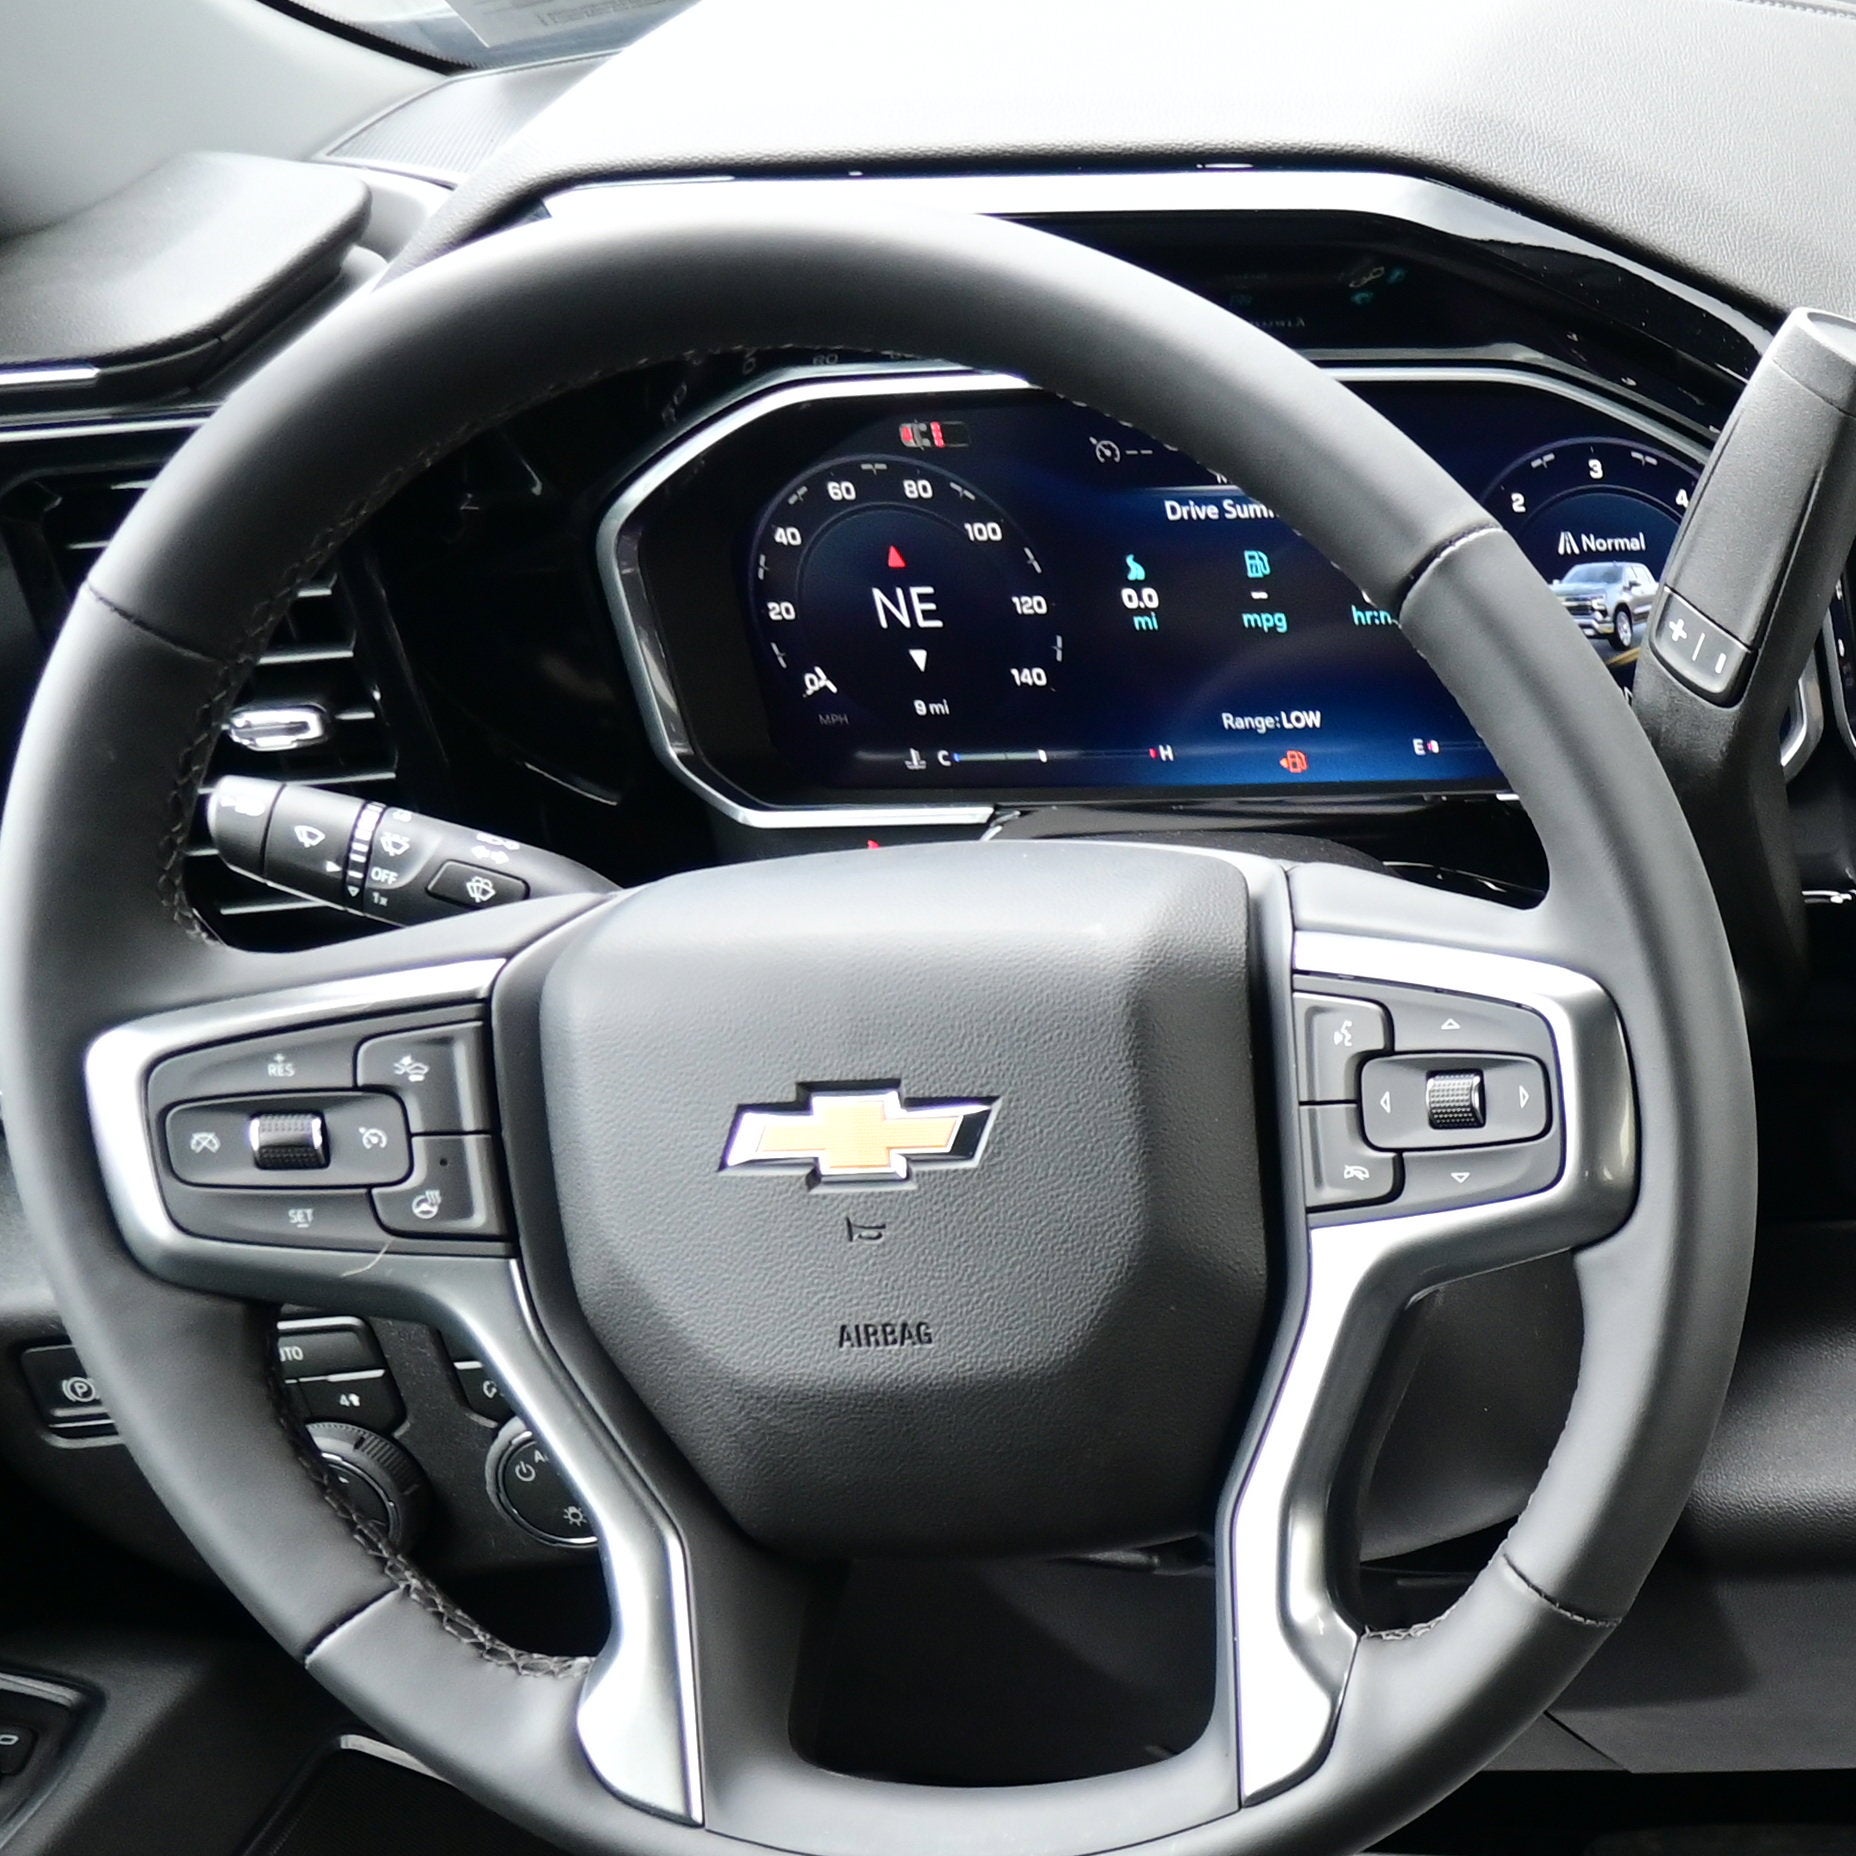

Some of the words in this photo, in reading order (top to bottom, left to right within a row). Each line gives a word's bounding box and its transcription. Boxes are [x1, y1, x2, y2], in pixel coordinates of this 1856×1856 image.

[1587, 458, 1604, 479] 3
[827, 481, 857, 502] 60
[903, 479, 933, 500] 80
[1675, 488, 1689, 508] 4
[1164, 500, 1219, 521] Drive
[1510, 491, 1527, 513] 2
[774, 526, 802, 547] 40
[964, 522, 1003, 542] 100
[1580, 531, 1647, 552] Normal
[872, 586, 944, 629] NE
[1012, 595, 1048, 616] 120
[1121, 587, 1160, 610] 0.0
[767, 601, 796, 621] 20
[1133, 611, 1159, 633] mi
[1242, 612, 1288, 633] mpg
[1010, 666, 1047, 688] 140
[914, 699, 927, 717] 9
[929, 699, 950, 716] mi
[819, 711, 850, 727] MPH
[1221, 710, 1279, 734] Range:
[1281, 710, 1322, 730] LOW
[1160, 744, 1175, 762] H
[1412, 738, 1426, 756] E
[937, 749, 952, 767] C
[371, 866, 398, 885] OFF
[267, 1062, 295, 1077] RES
[288, 1208, 314, 1224] SET
[839, 1320, 933, 1348] AIRBAG
